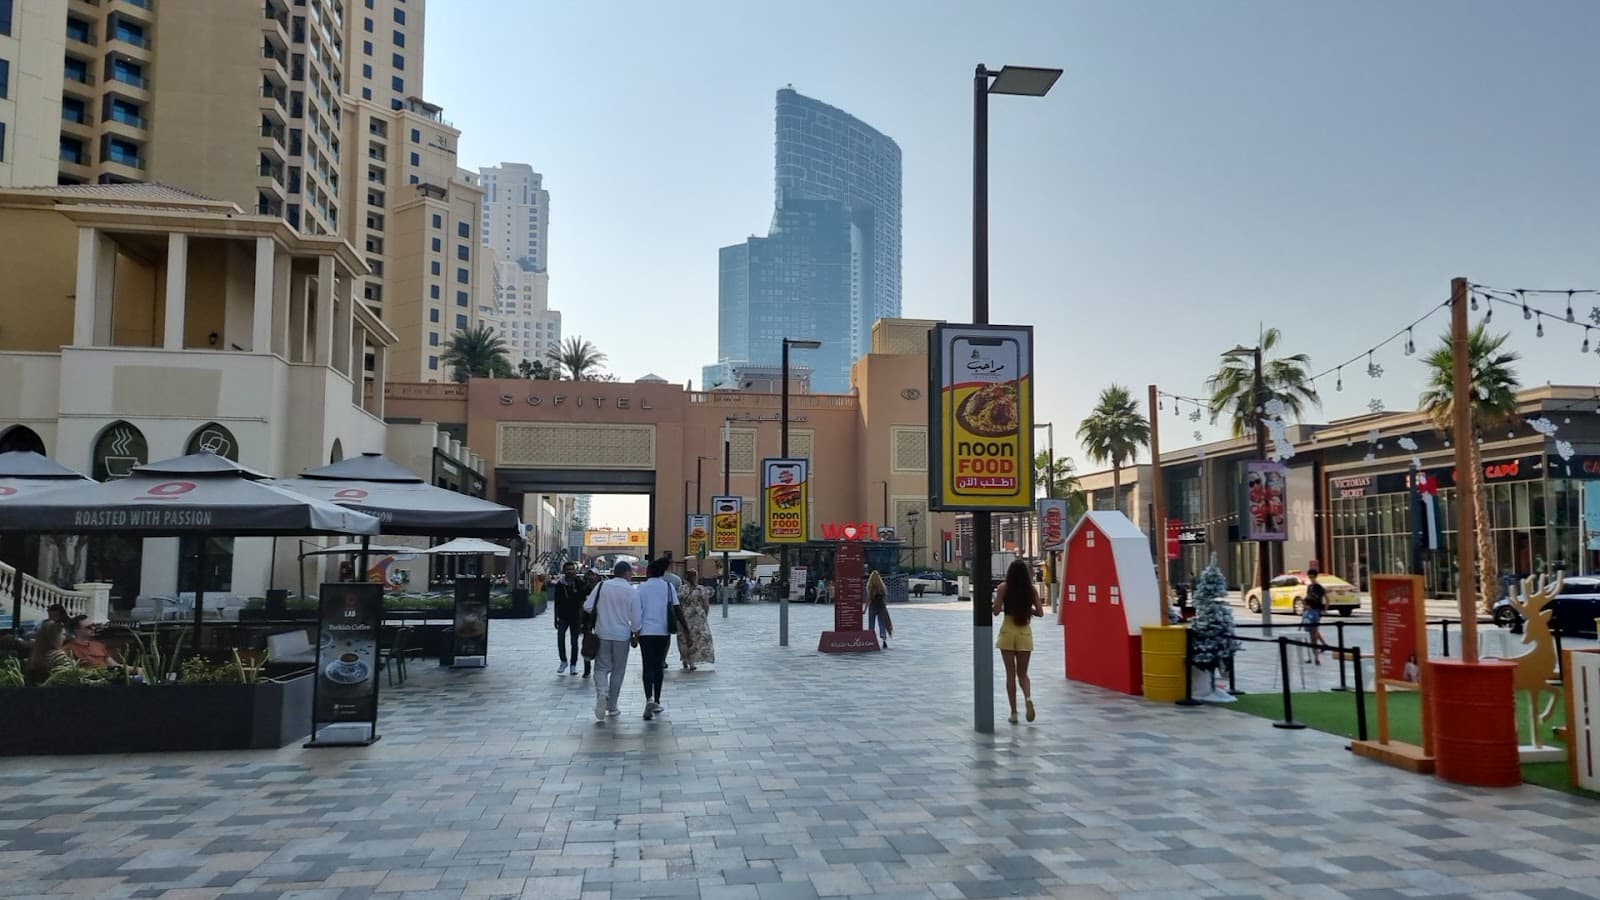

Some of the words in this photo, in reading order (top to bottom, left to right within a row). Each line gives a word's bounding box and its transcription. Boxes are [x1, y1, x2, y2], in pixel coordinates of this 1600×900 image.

[500, 394, 653, 409] SOFITEL
[958, 441, 1014, 457] noon
[958, 458, 1014, 474] FOOD
[75, 511, 127, 526] ROASTED
[130, 511, 160, 525] WITH
[163, 510, 212, 525] PASSION
[772, 512, 799, 520] noon
[772, 520, 799, 528] FOOD
